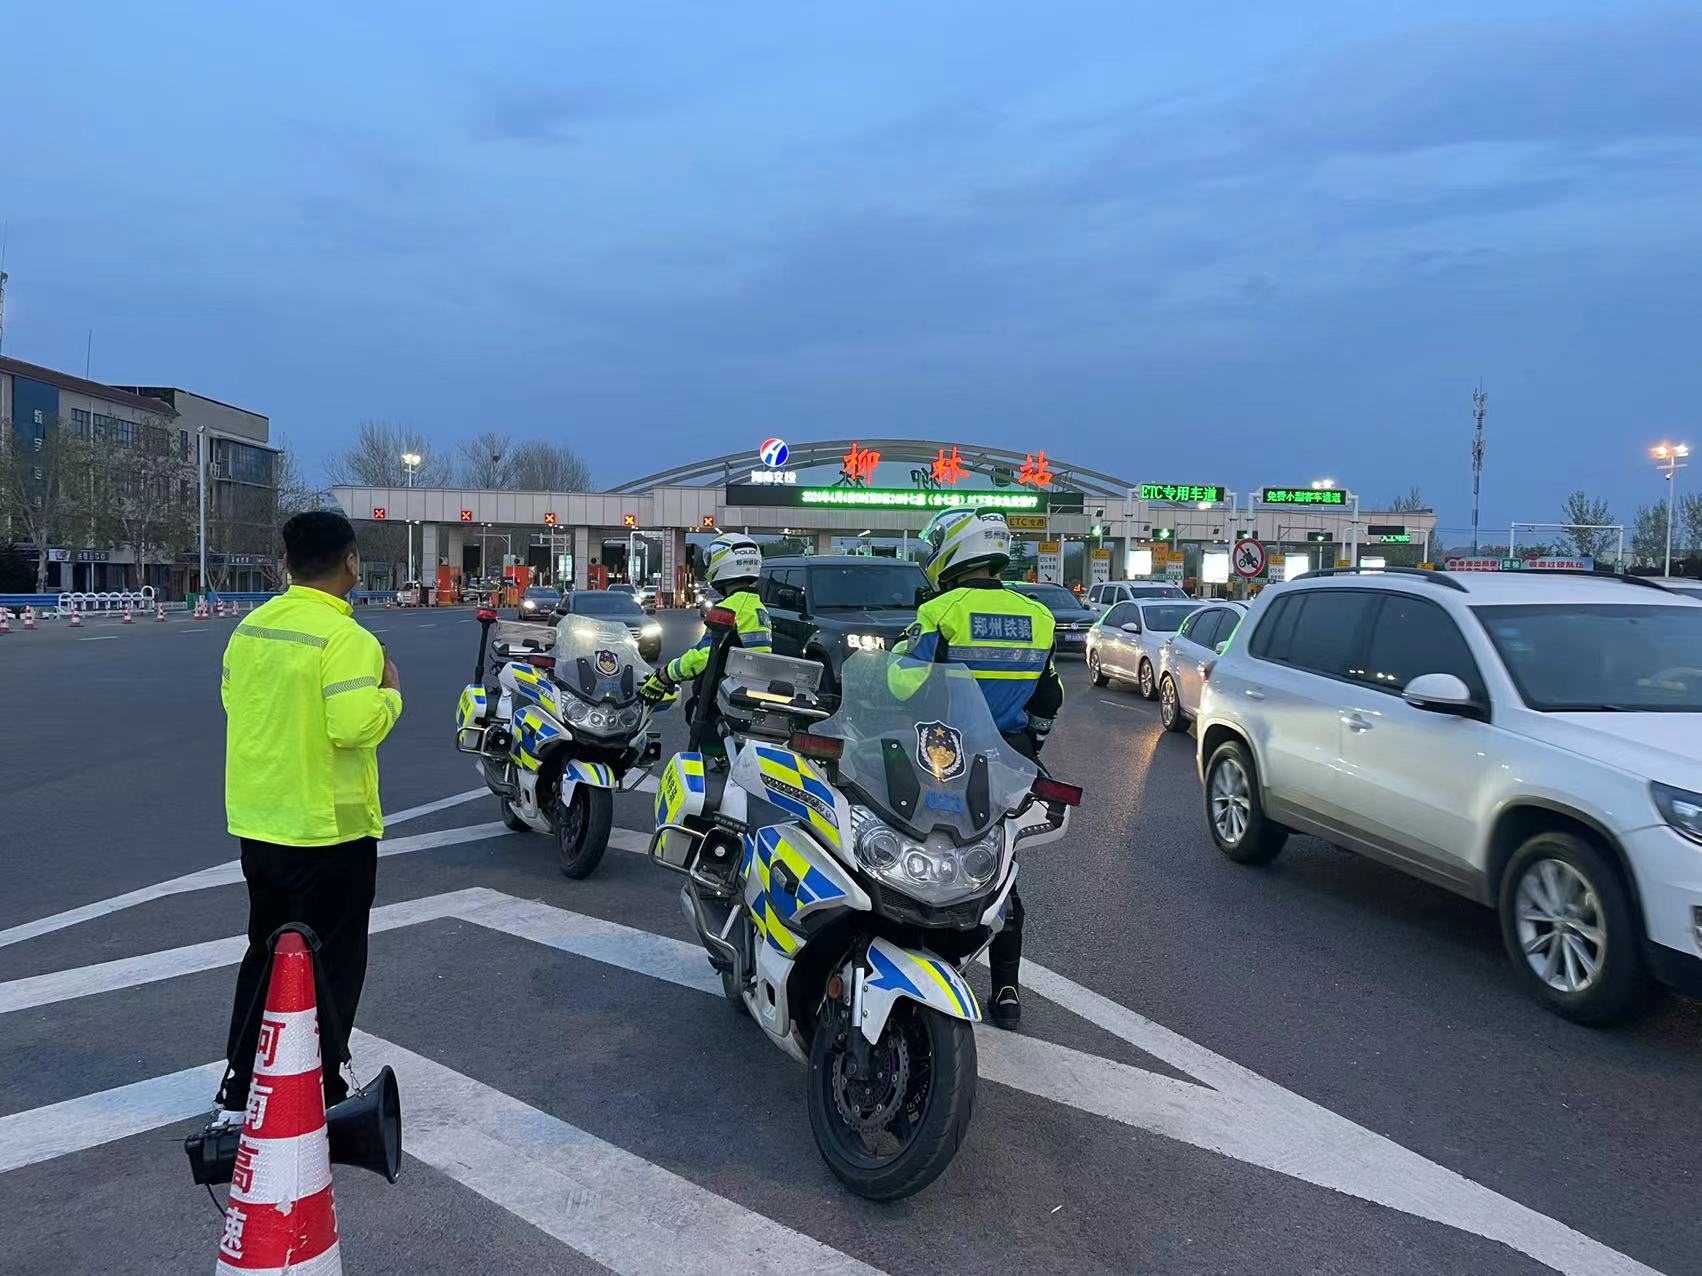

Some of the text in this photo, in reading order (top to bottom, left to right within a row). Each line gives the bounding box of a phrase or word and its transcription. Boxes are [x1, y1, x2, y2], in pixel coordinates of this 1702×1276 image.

[843, 442, 1052, 488] 柳林站
[1141, 485, 1217, 502] ETC专用车道
[1009, 517, 1045, 527] ETC专用
[973, 616, 1031, 638] 郑州铁骑
